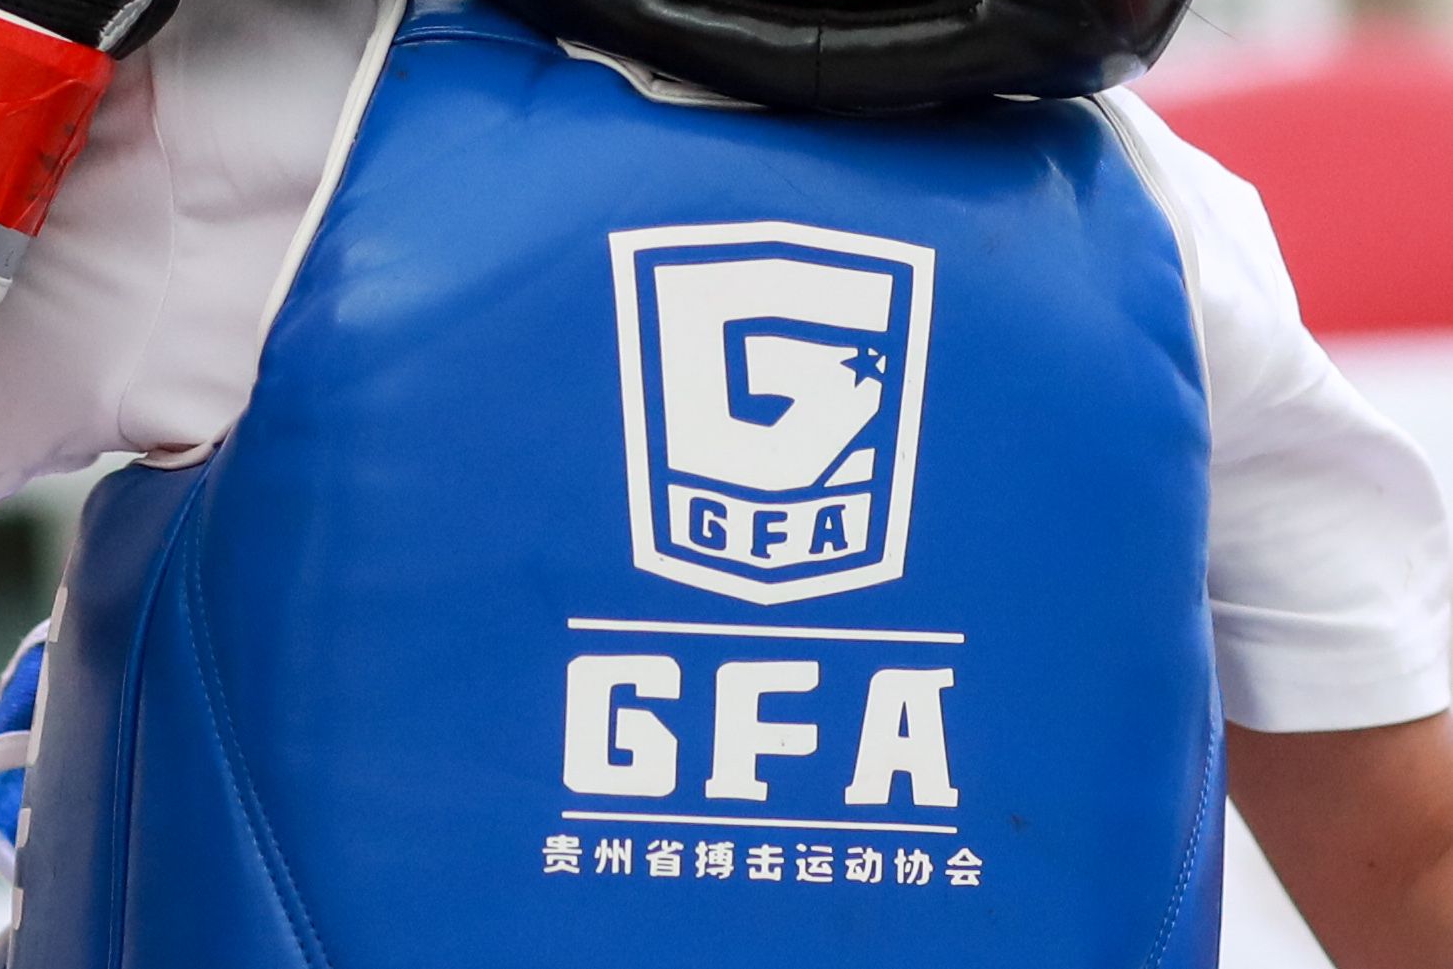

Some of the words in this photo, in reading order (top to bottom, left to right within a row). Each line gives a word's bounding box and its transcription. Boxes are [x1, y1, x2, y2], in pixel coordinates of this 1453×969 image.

[688, 497, 849, 559] GFA
[562, 654, 960, 808] GFA
[542, 834, 984, 887] 贵州省搏击运动协会
